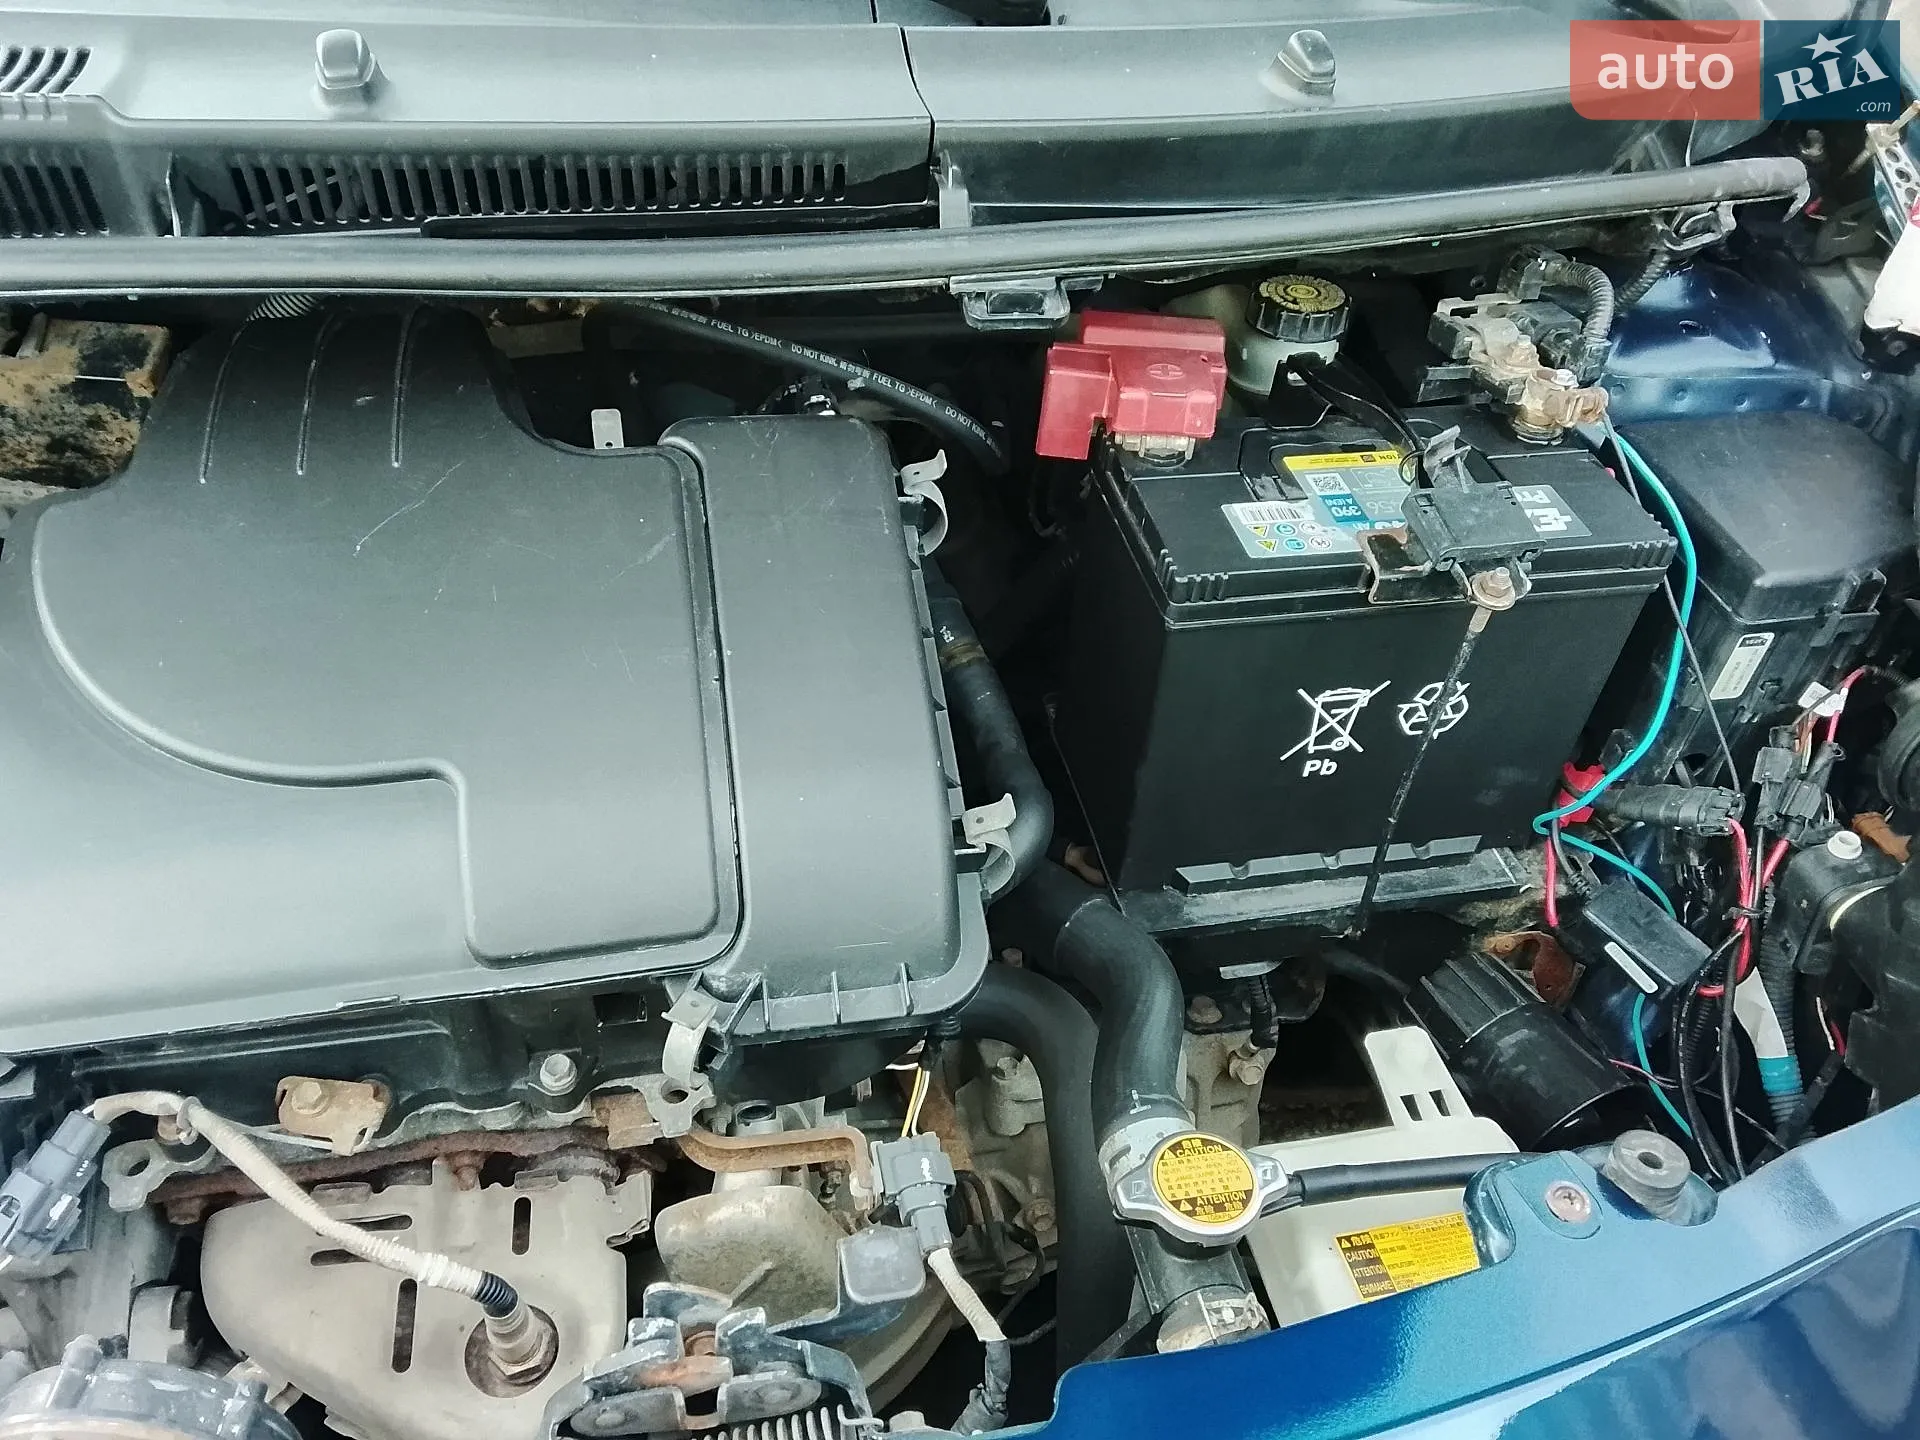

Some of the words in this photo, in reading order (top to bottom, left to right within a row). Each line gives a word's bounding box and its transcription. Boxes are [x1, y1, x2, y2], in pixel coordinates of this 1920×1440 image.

[711, 319, 734, 333] FUEL
[791, 343, 802, 354] DO
[803, 347, 820, 360] NOT
[872, 372, 892, 388] FUEL
[945, 406, 957, 418] DO
[957, 413, 973, 428] NOT
[1331, 506, 1361, 517] 390
[1302, 758, 1338, 777] Pb
[1176, 1145, 1223, 1158] CAUTION
[1197, 1190, 1247, 1206] ATTENTION
[1345, 1248, 1380, 1262] CAUTION
[1353, 1264, 1387, 1278] ATTENTION
